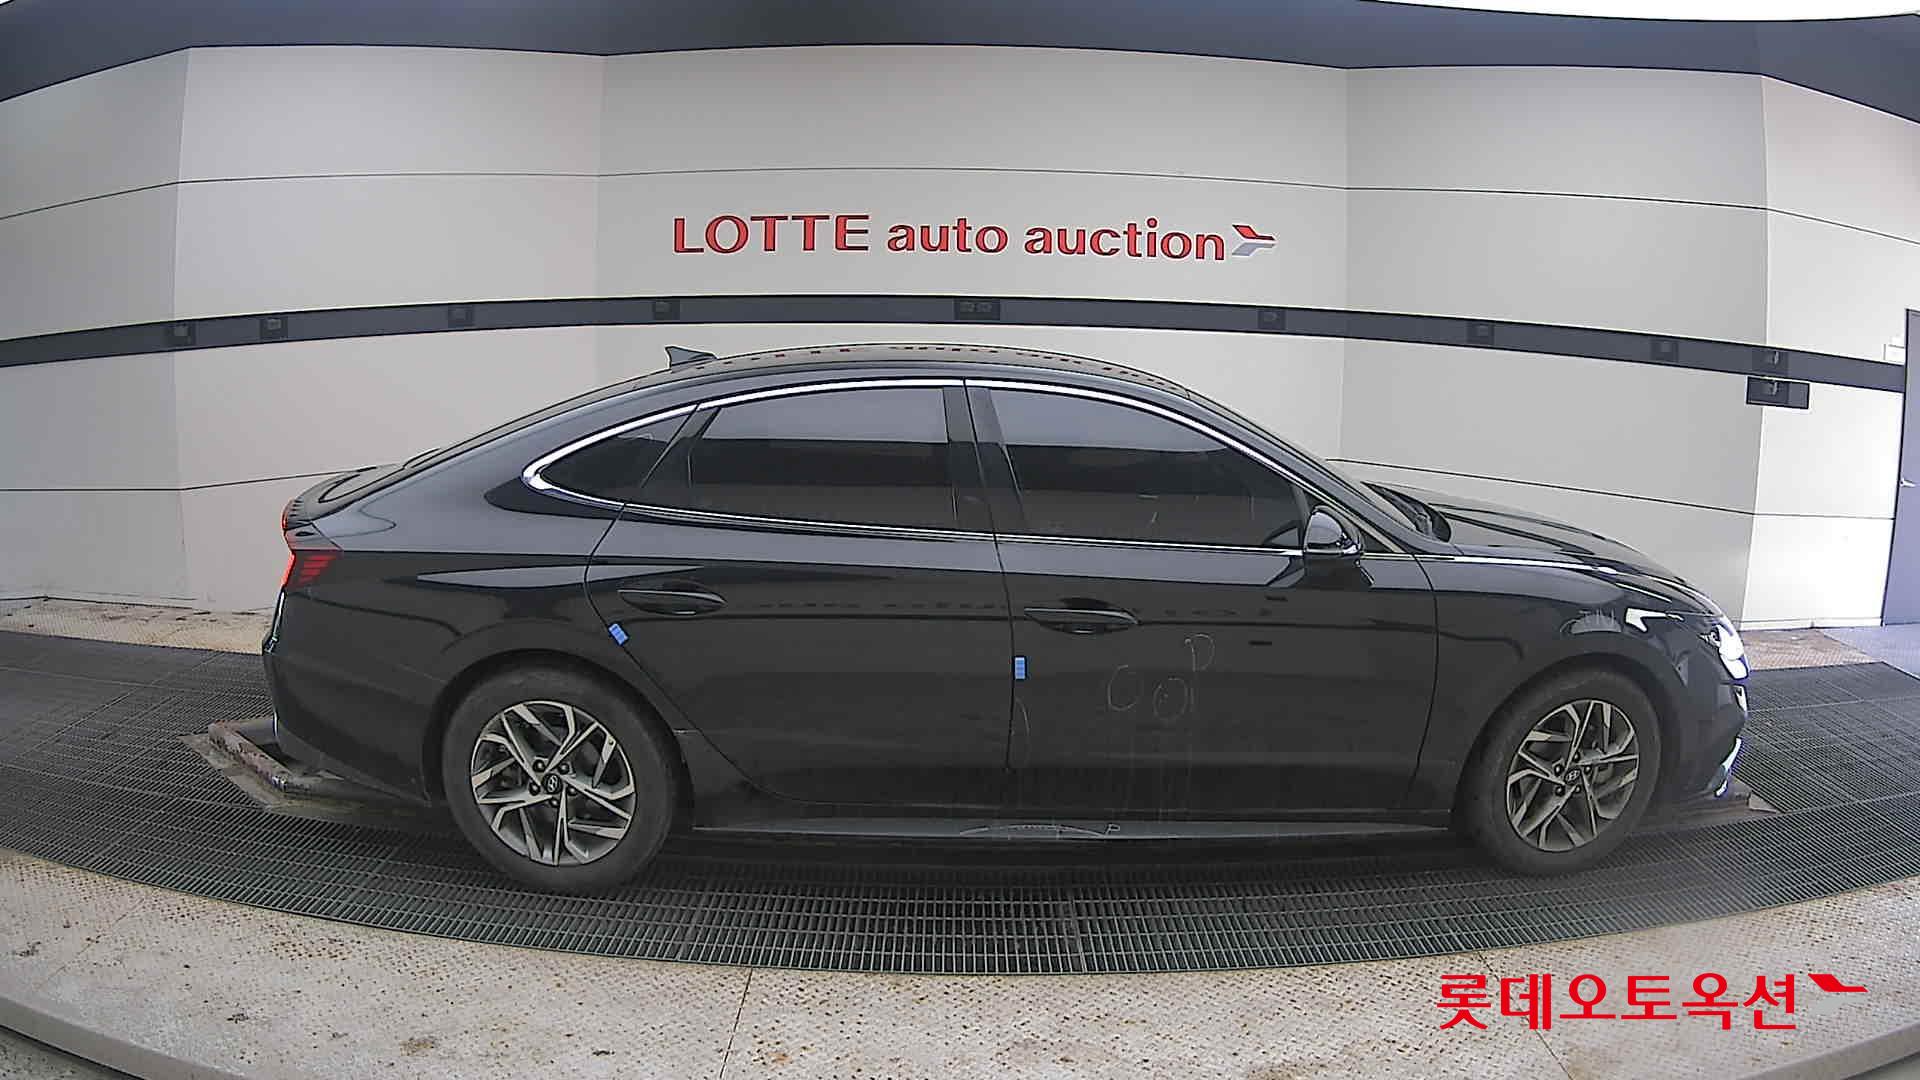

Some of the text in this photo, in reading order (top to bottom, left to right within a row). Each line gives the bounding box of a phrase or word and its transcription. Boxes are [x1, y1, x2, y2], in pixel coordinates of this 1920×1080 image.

[673, 214, 1225, 261] LOTTE auto auction
